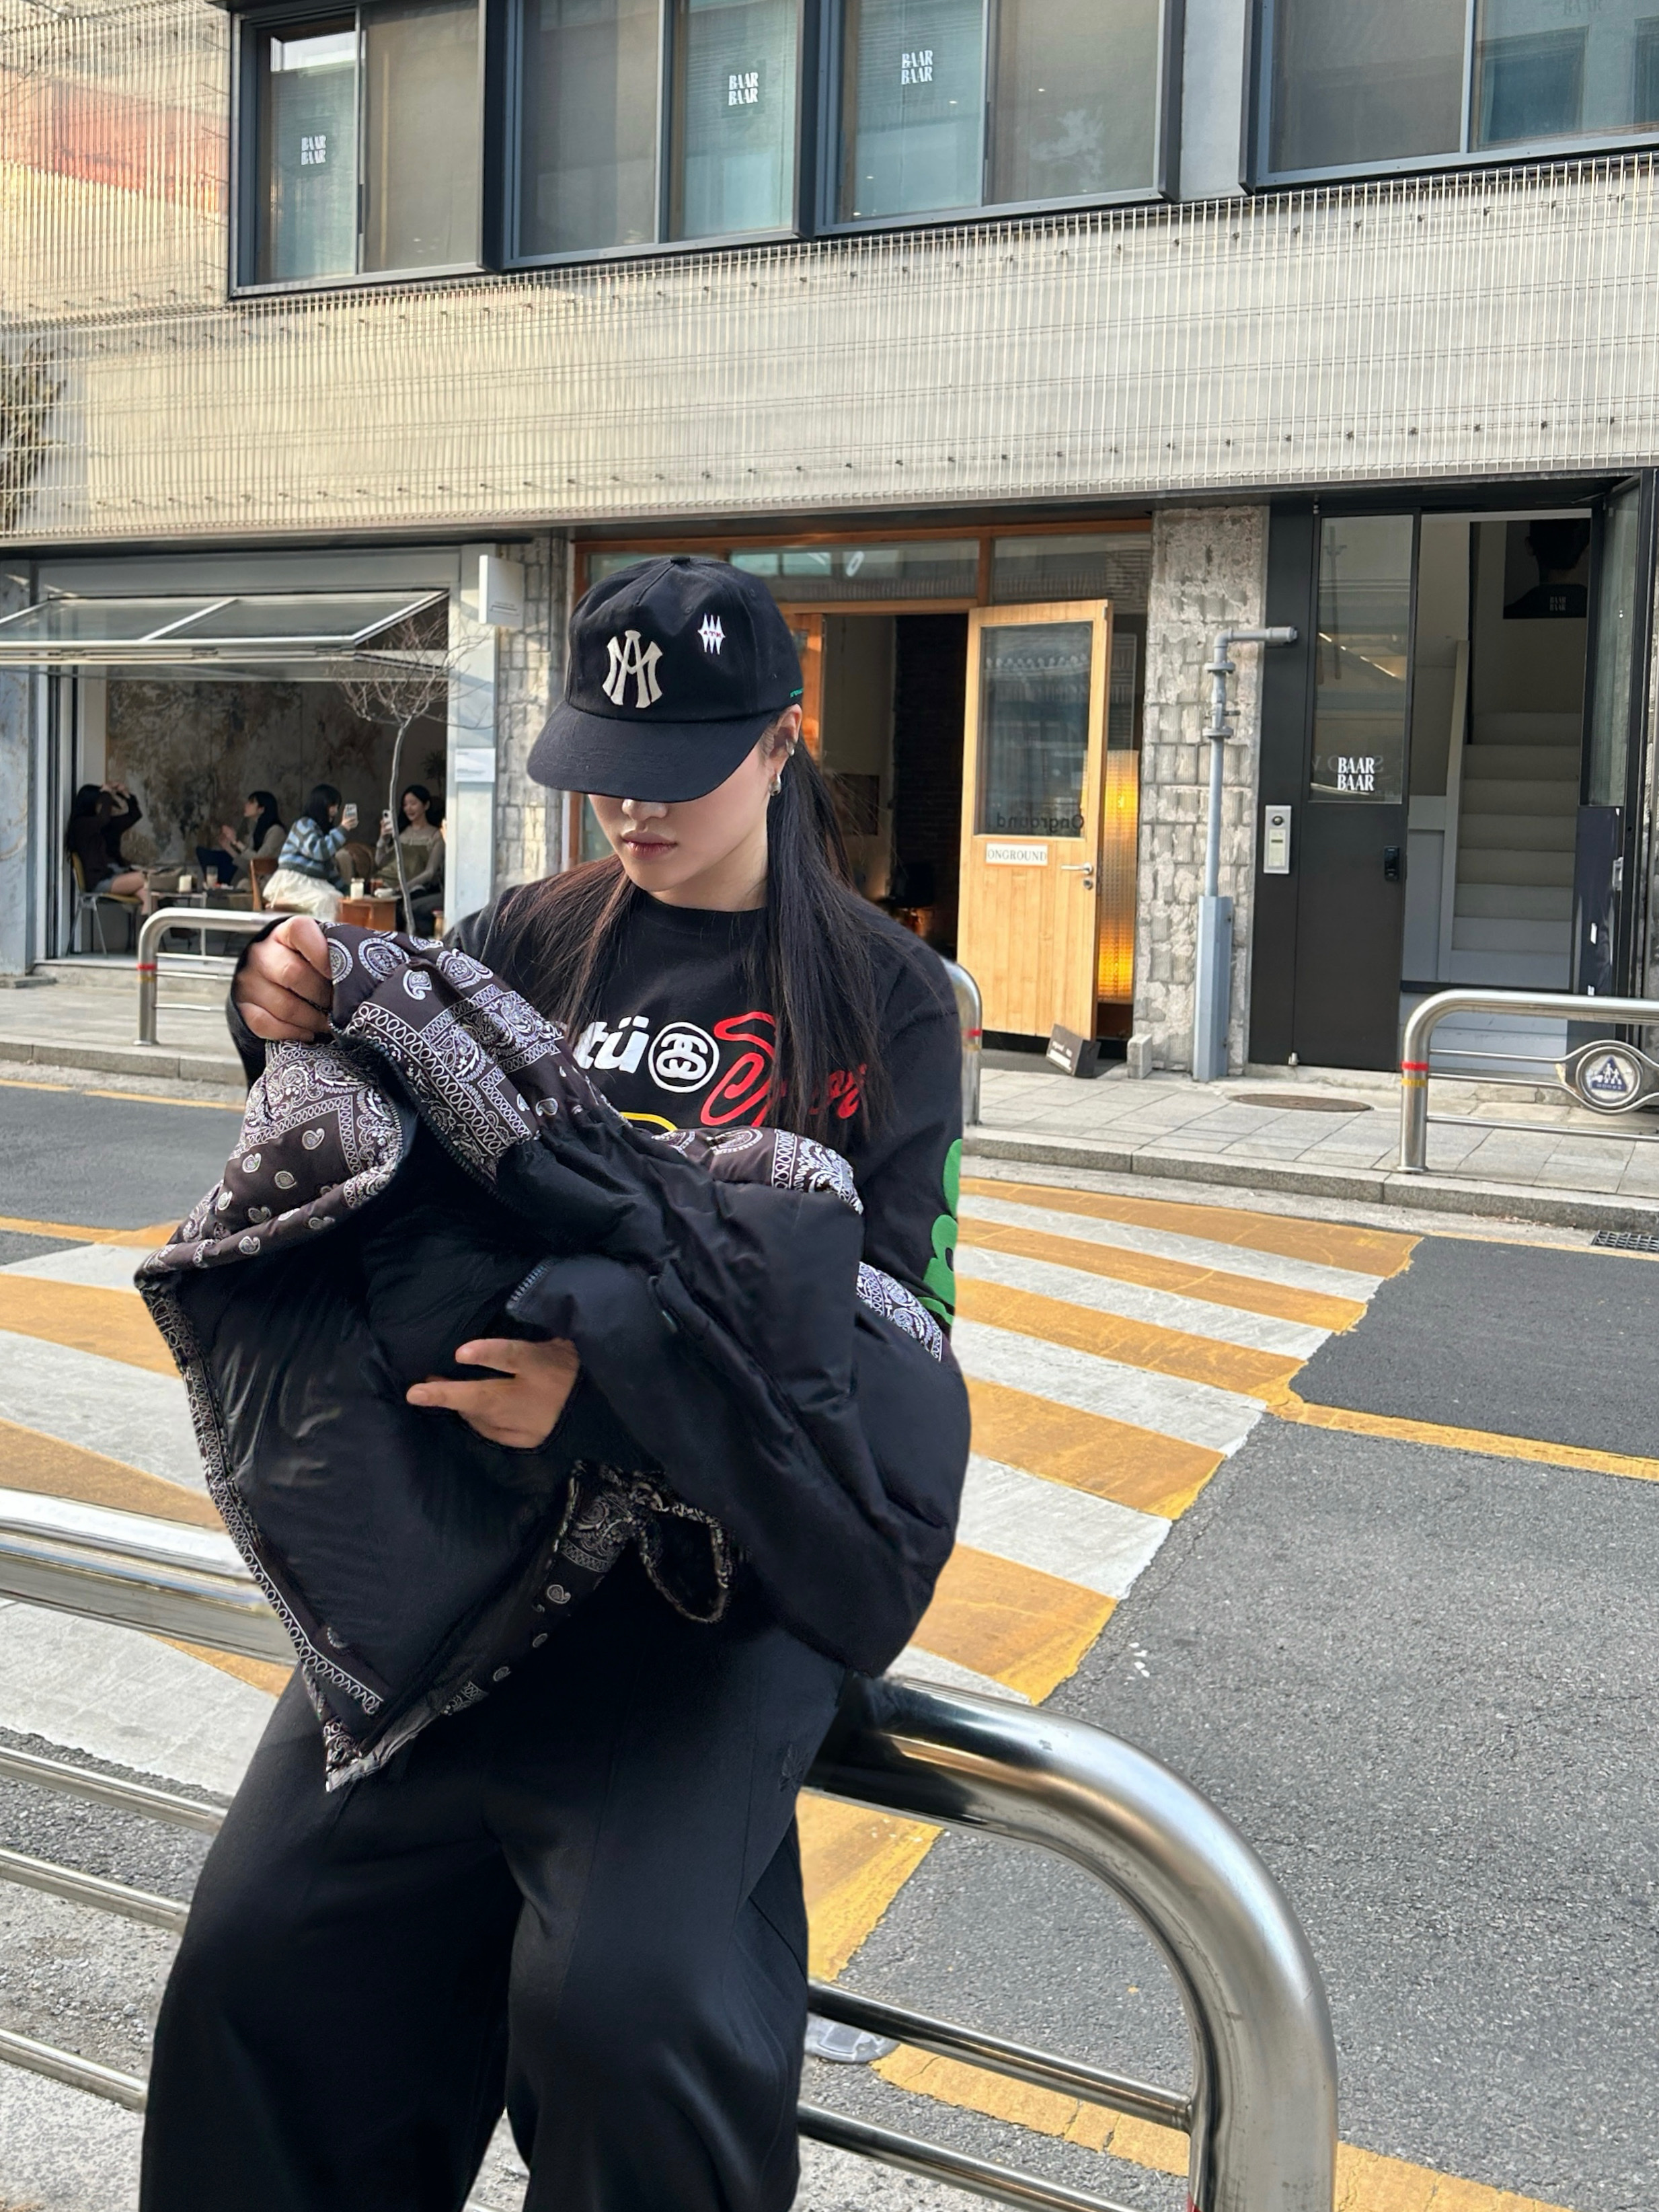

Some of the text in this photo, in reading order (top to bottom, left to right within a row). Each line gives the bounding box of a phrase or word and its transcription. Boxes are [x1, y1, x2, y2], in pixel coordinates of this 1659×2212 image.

[902, 50, 933, 69] BAAR
[728, 71, 759, 91] BAAR
[901, 66, 933, 85] BAAR
[728, 87, 759, 106] BAAR
[1337, 756, 1375, 774] BAAR
[1337, 773, 1375, 792] BAAR
[987, 848, 1048, 862] ONGROUND
